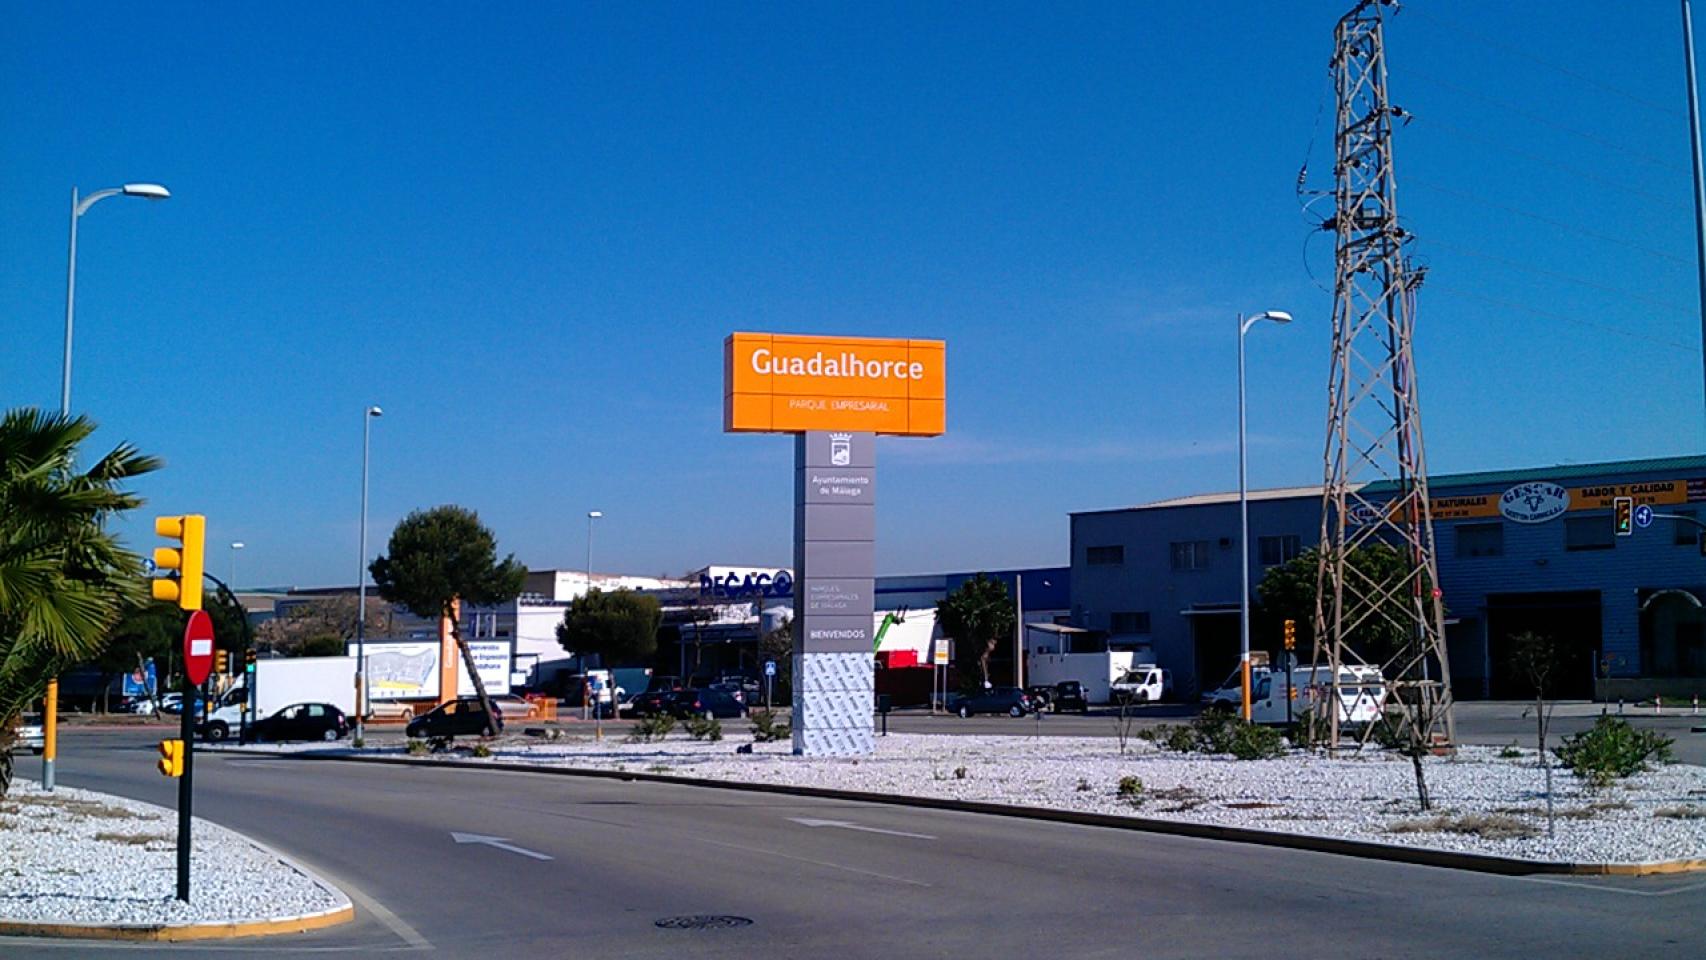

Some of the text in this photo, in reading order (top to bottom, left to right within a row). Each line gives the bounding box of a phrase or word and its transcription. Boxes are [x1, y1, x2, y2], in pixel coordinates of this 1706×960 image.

[752, 348, 924, 379] Guadalhorce
[789, 400, 888, 411] PARQUE EMPRESARIAL
[812, 475, 869, 485] Ayuntamiento
[820, 487, 830, 495] de
[1582, 482, 1674, 498] SABOR Y CALIDAD
[1437, 497, 1487, 508] NATURALES
[810, 629, 865, 639] BIENVENIDOS
